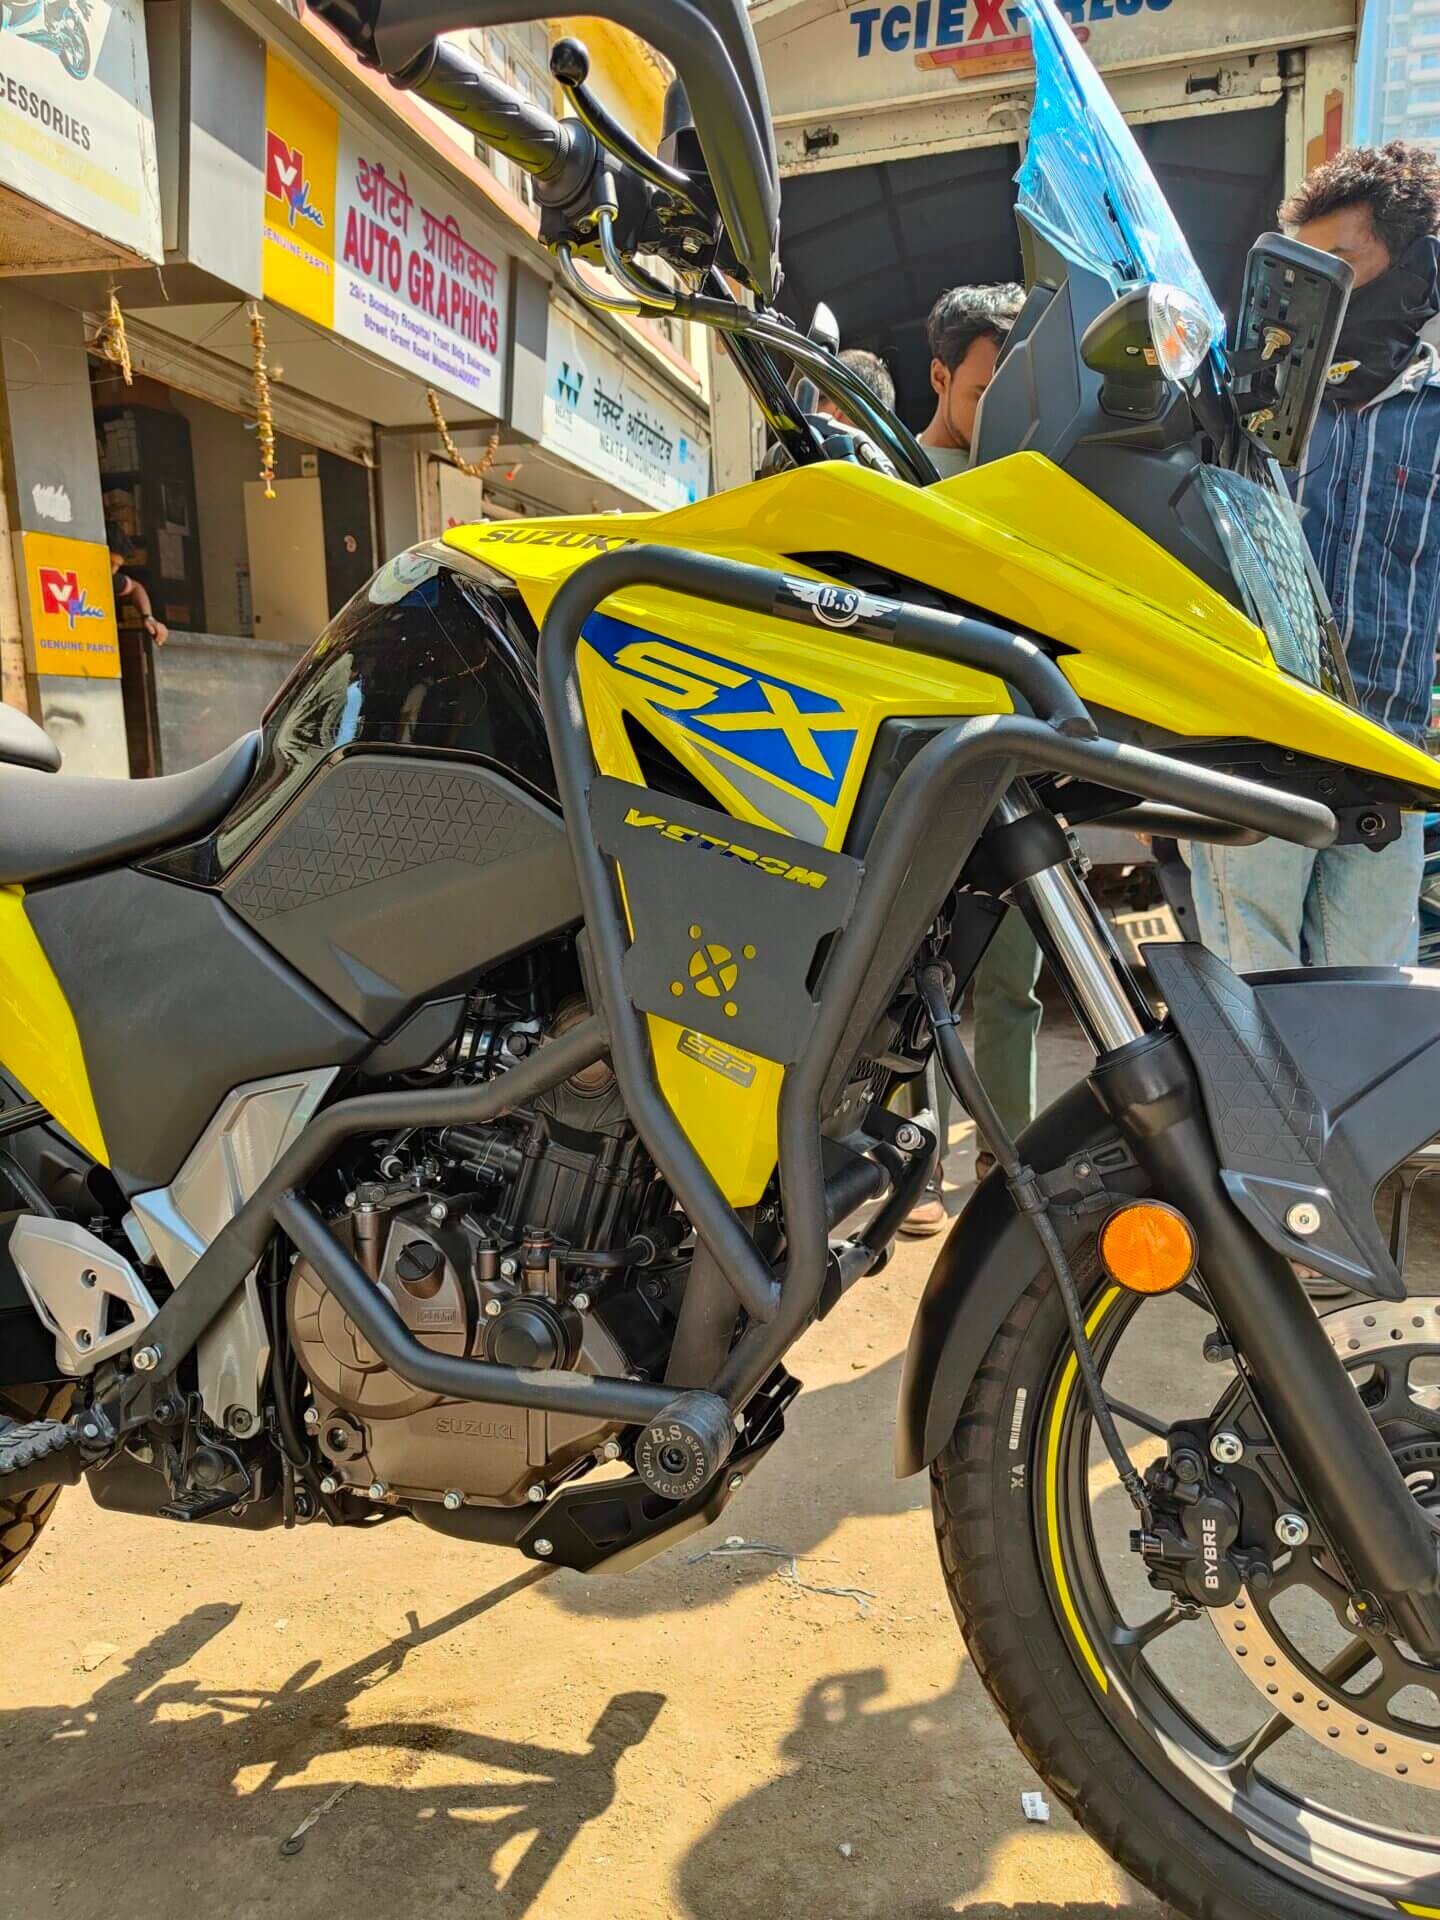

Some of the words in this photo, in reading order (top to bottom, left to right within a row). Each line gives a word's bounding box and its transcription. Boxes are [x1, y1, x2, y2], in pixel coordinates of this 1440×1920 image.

[343, 205, 402, 292] AUTO
[408, 250, 498, 354] GRAPHICS
[40, 639, 82, 651] GENUINE
[86, 643, 116, 654] PARTS
[613, 641, 858, 780] SX
[683, 1035, 751, 1073] SEP
[432, 1417, 518, 1440] SUZUKI
[649, 1424, 682, 1444] B.S
[641, 1442, 655, 1478] AUTO
[1202, 1519, 1219, 1589] BYBRE
